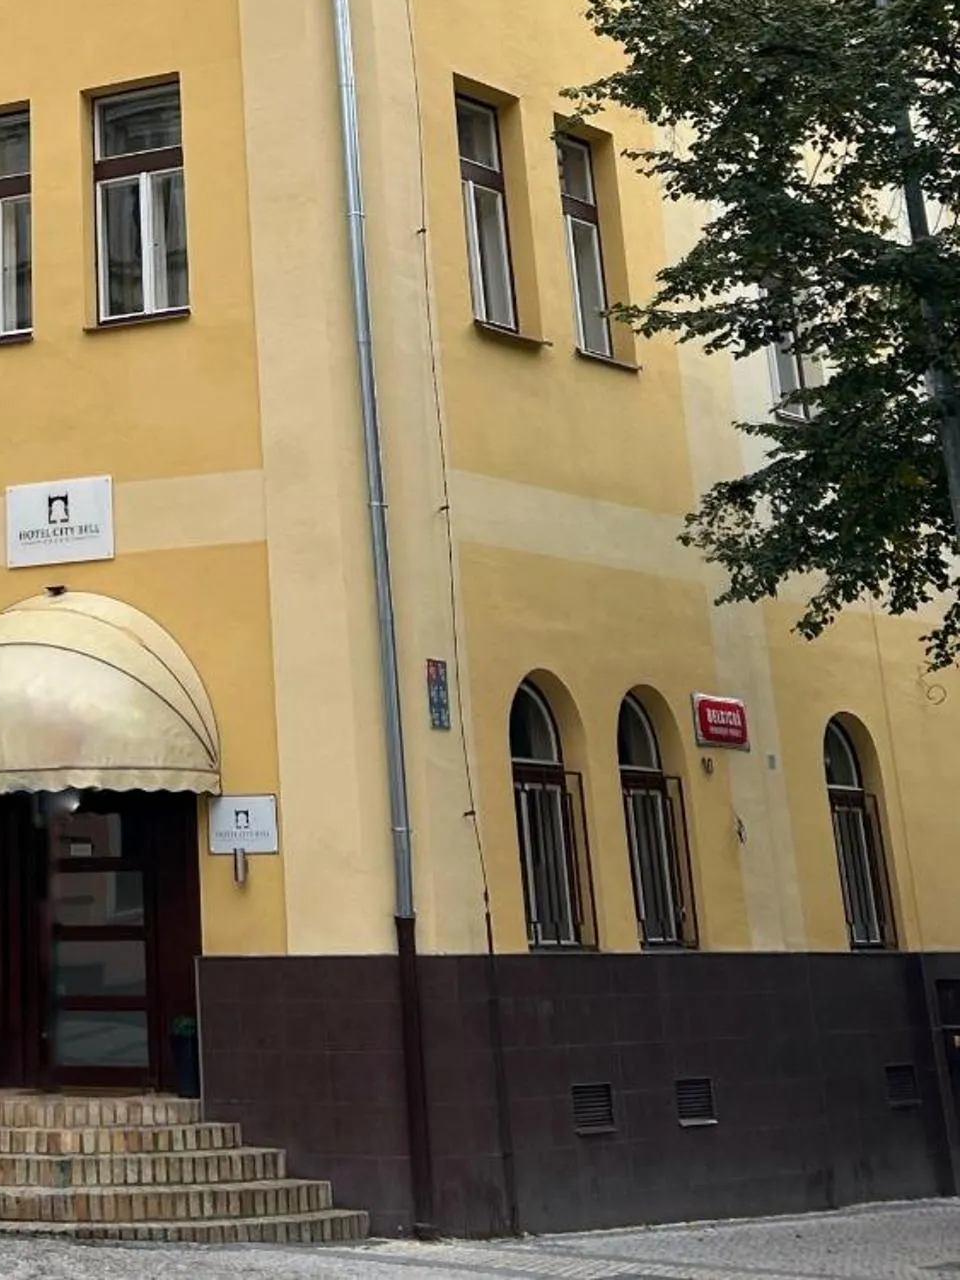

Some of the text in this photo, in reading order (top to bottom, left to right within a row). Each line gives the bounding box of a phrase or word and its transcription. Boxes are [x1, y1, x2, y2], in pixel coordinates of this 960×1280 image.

[19, 523, 100, 541] HOTEL CITY BELL
